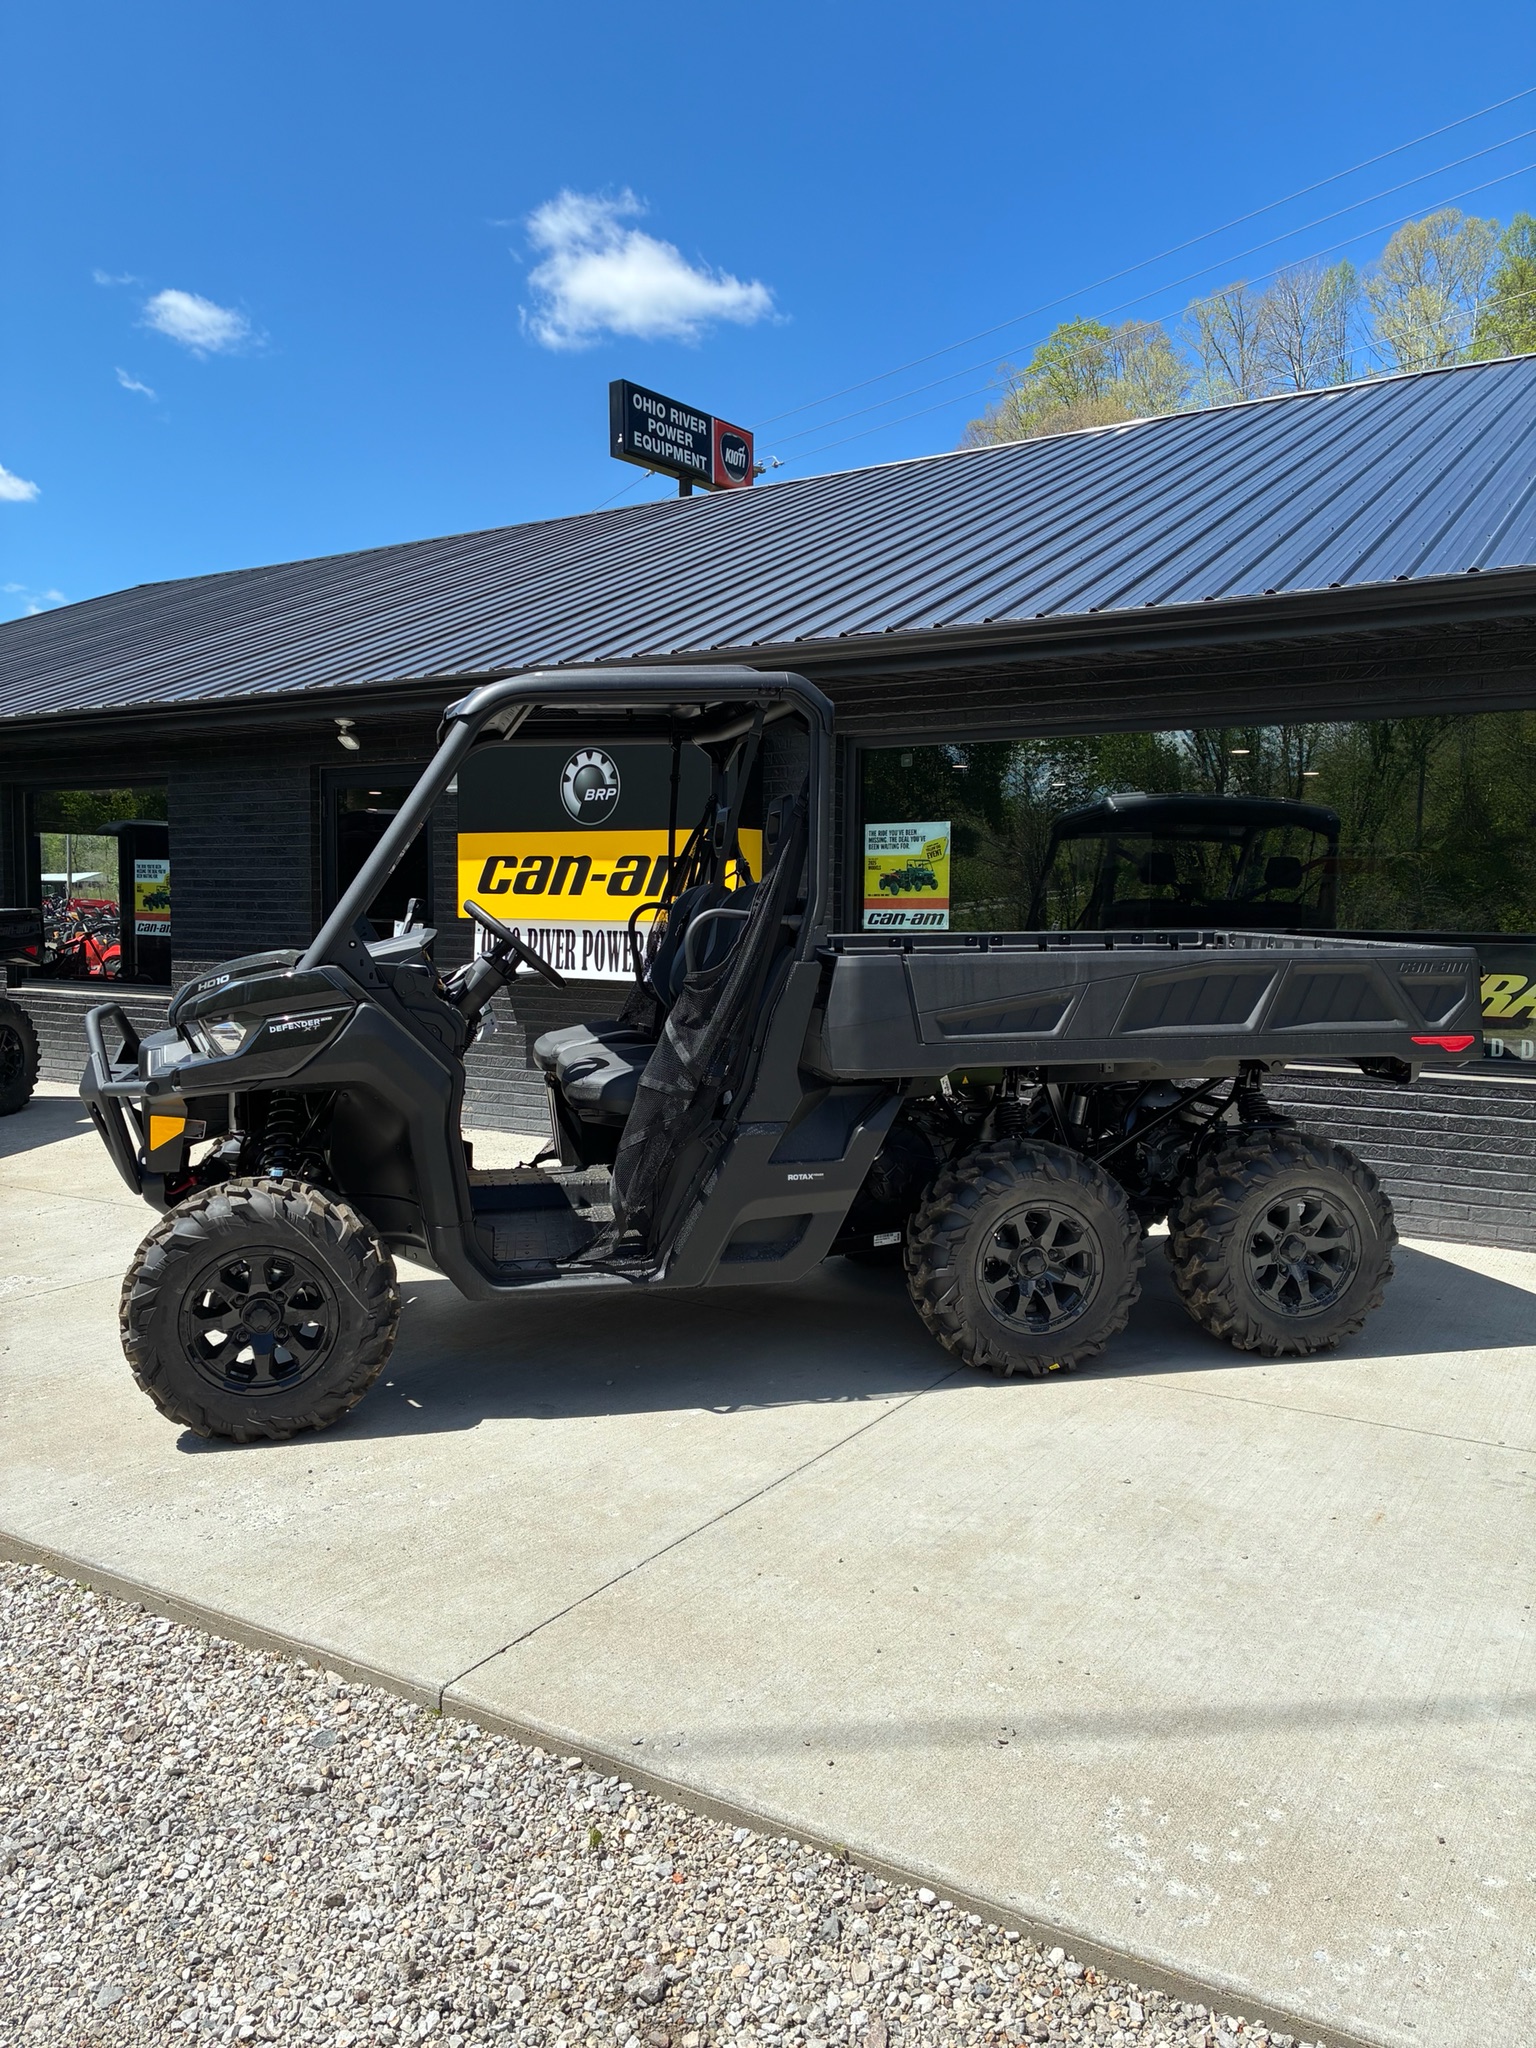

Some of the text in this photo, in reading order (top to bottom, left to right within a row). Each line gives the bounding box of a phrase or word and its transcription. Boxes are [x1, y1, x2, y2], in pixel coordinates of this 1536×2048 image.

[632, 393, 707, 436] OHIO RIVER
[647, 418, 693, 448] POWER
[633, 430, 707, 470] EQUIPMENT
[725, 446, 746, 468] KIOTI
[584, 788, 617, 801] BRP
[926, 848, 942, 859] EVENT
[867, 913, 944, 926] can-am
[198, 974, 230, 991] HD10
[269, 1018, 320, 1034] DEFENDER
[787, 1173, 814, 1181] ROTAX
